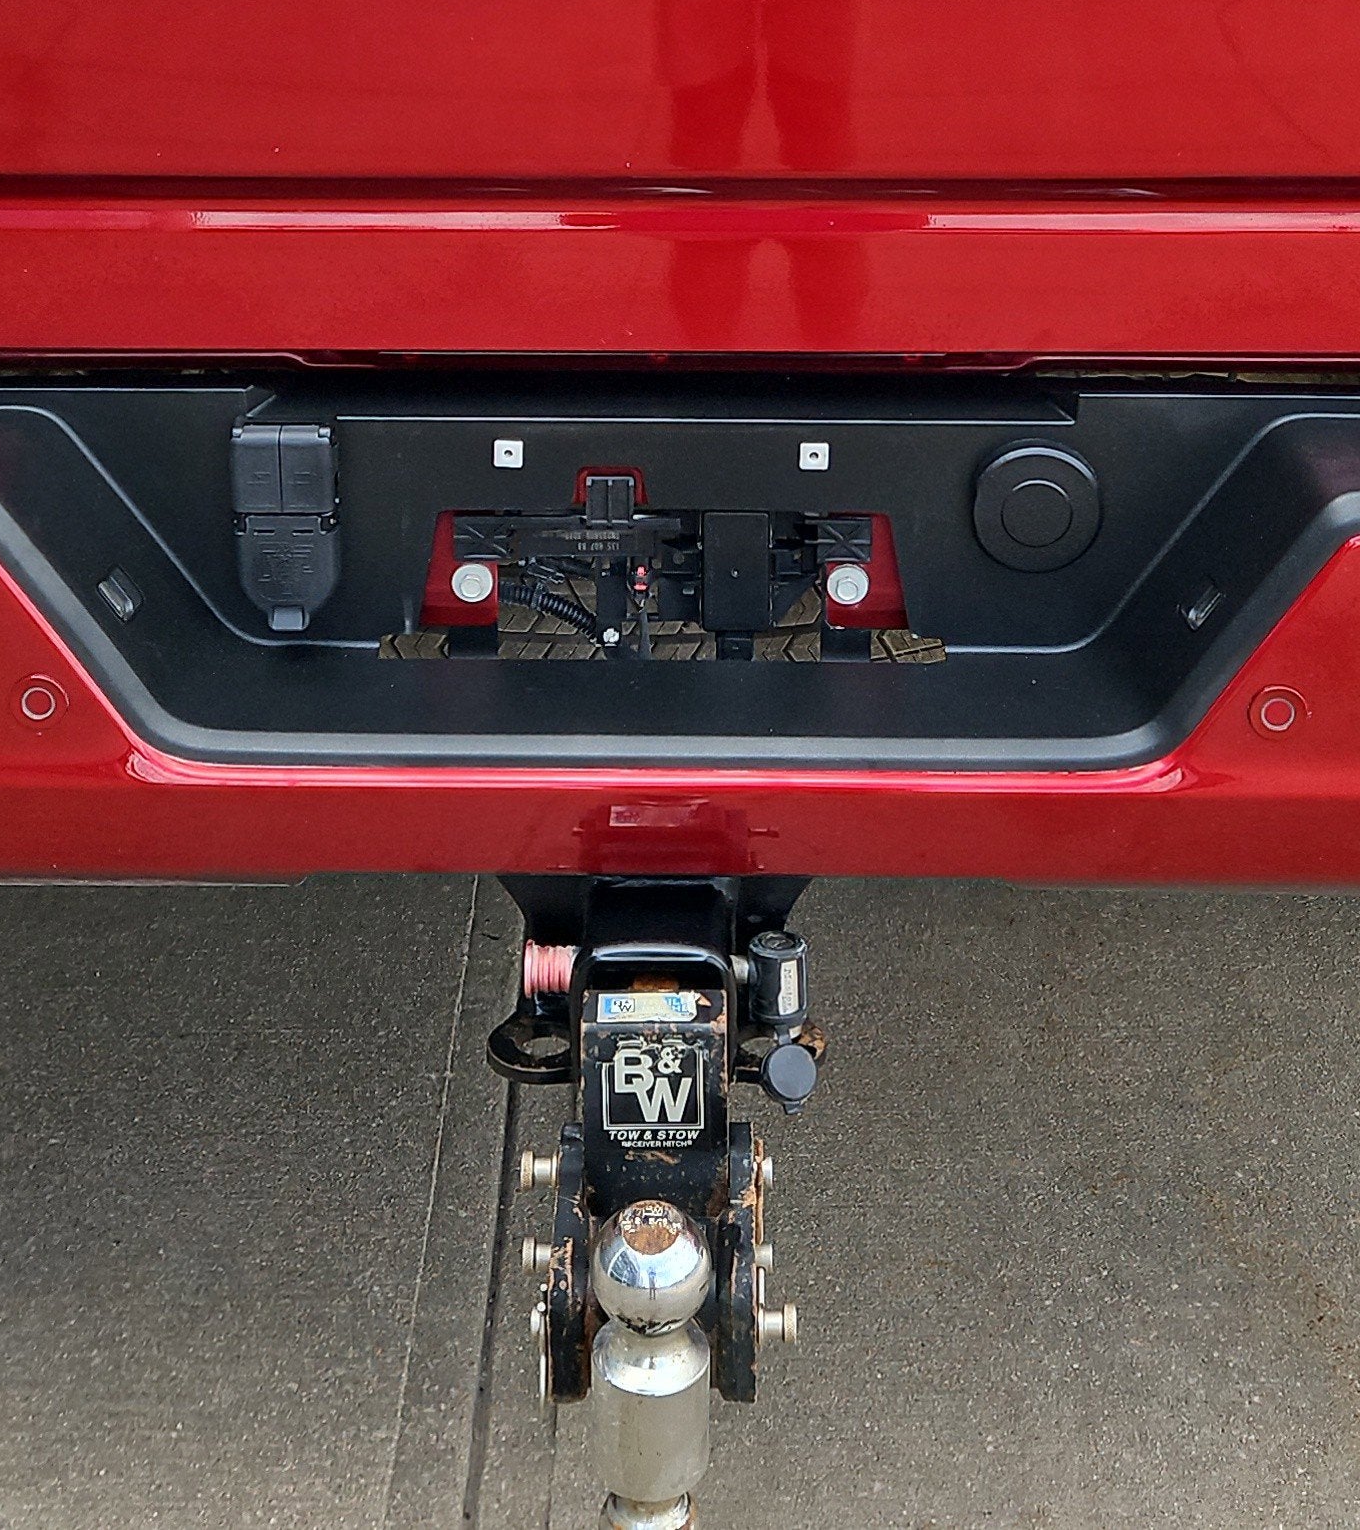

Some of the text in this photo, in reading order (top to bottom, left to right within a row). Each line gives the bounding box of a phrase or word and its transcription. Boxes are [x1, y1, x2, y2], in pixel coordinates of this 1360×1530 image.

[608, 1130, 700, 1141] TOW & STOW
